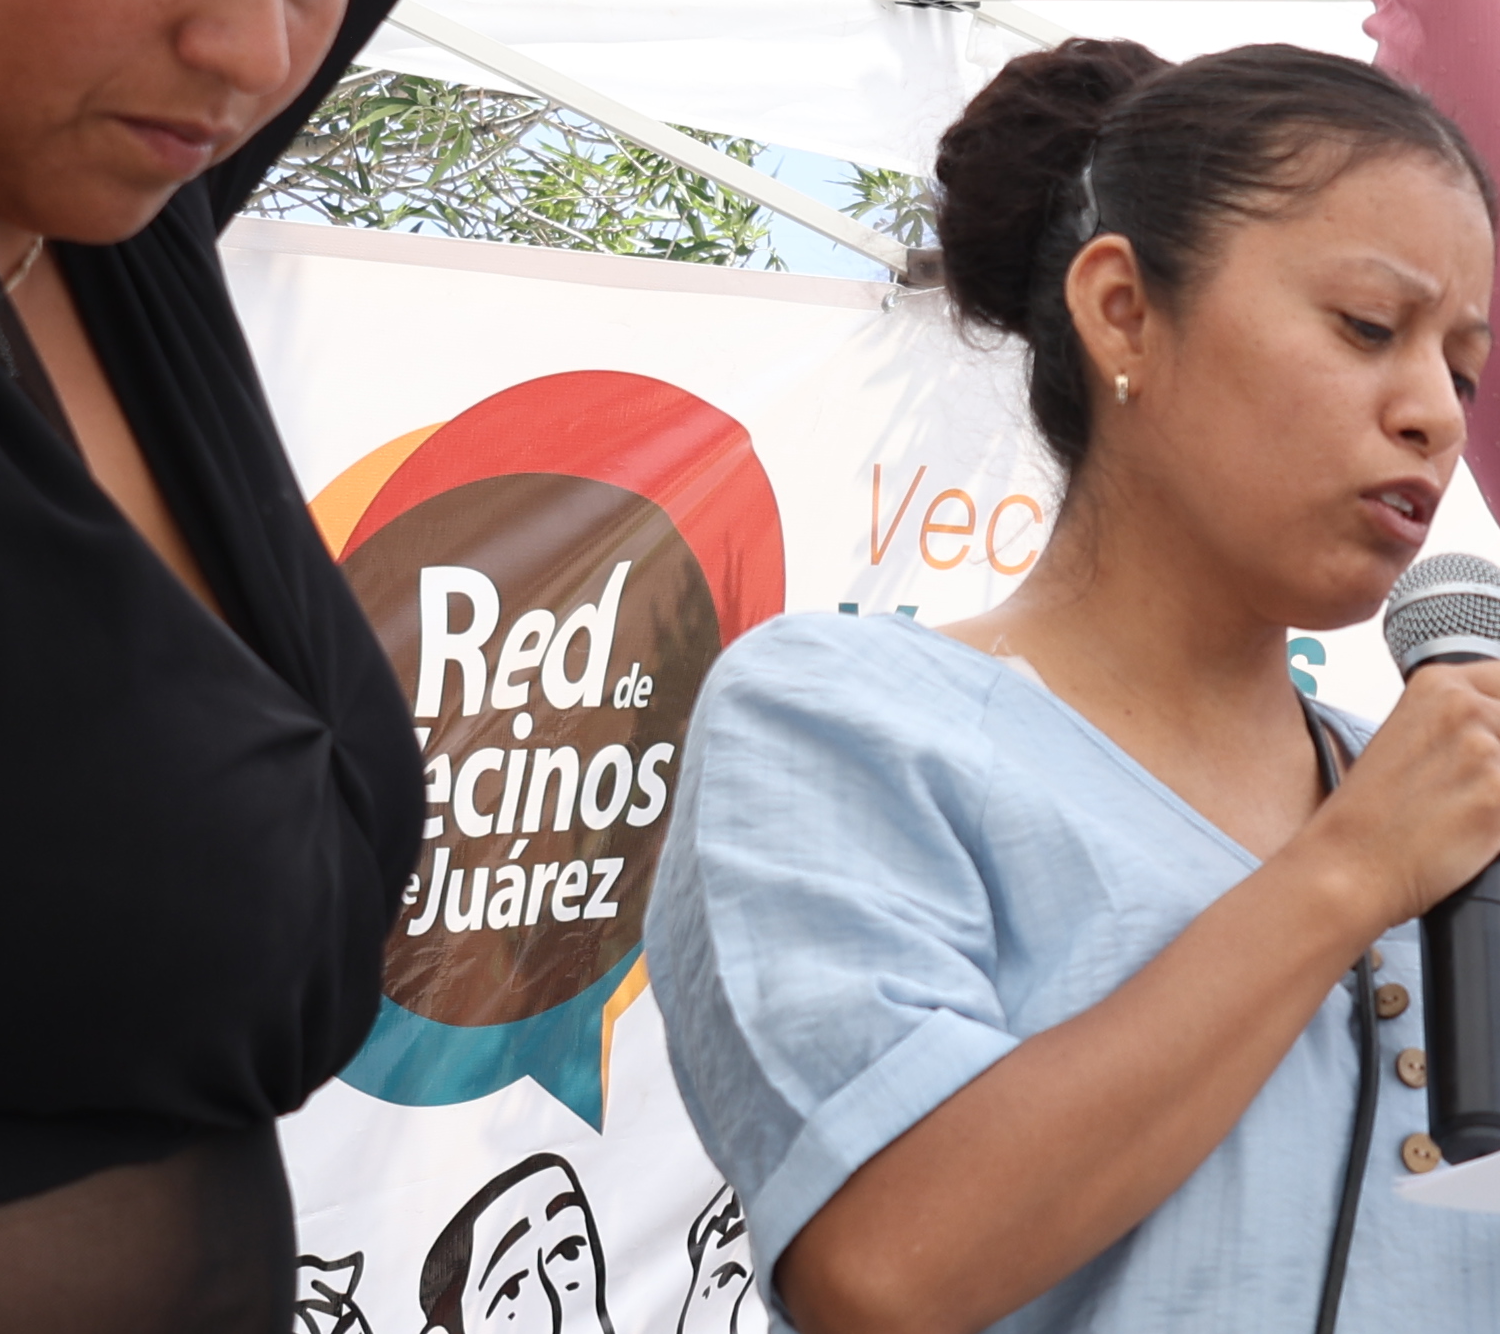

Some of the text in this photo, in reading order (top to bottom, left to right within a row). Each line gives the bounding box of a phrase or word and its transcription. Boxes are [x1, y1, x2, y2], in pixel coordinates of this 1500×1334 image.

[870, 463, 1044, 576] Vec
[414, 559, 654, 718] Red de
[414, 711, 675, 840] ecinos
[402, 839, 625, 937] e Juárez
